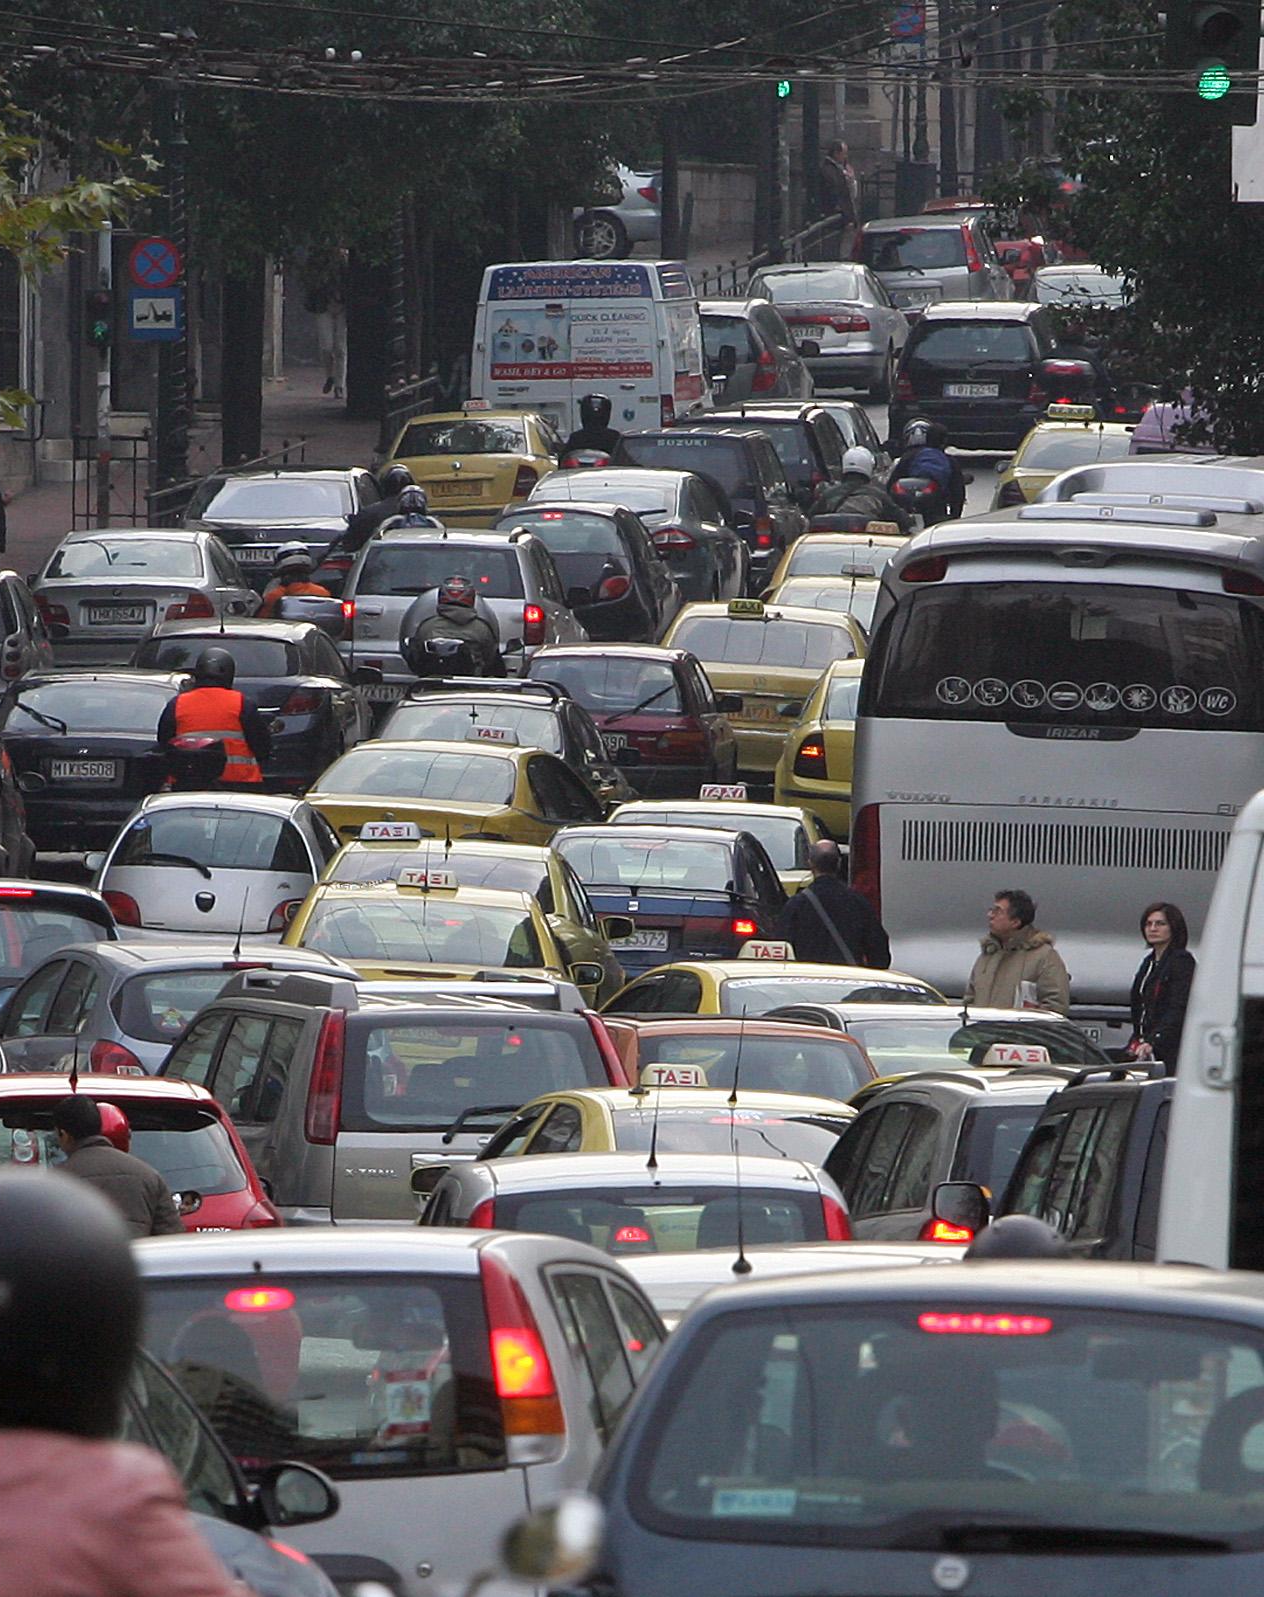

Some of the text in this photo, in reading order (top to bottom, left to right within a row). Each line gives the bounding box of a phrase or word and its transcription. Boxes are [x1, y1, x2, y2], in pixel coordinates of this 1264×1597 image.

[1206, 694, 1229, 709] WC
[476, 729, 505, 739] ΤΑΞΙ
[1046, 728, 1100, 739] IRIZAR
[702, 787, 744, 798] TAXI
[885, 791, 952, 804] VOLVO
[369, 827, 410, 837] ΤΑΞΙ
[406, 873, 449, 885] ΤΑΞΙ
[751, 945, 787, 958] ΤΑΞΙ
[994, 1048, 1047, 1063] ΤΑΞΙ
[653, 1070, 699, 1085] ΤΑΞΙ
[344, 1168, 398, 1178] X-TRAIL
